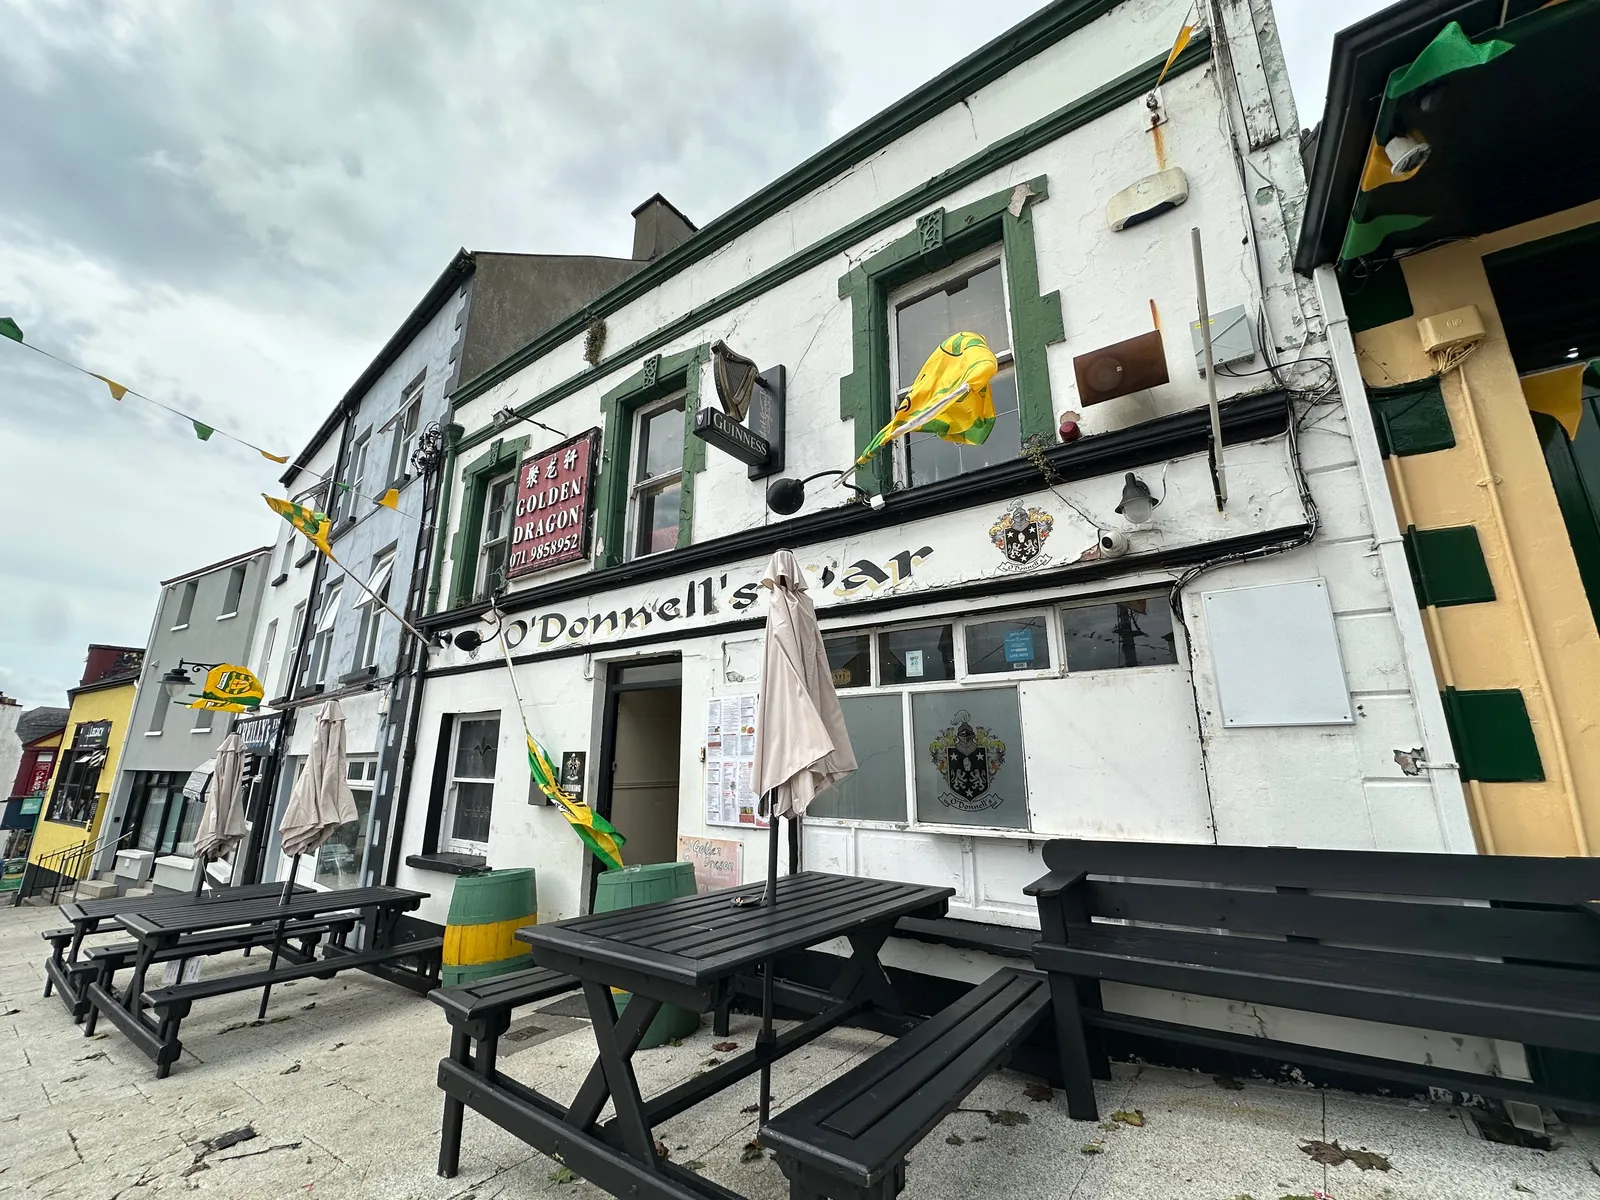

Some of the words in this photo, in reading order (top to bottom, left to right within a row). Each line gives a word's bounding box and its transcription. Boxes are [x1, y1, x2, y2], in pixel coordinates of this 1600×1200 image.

[713, 412, 767, 456] GUINNESS
[516, 476, 583, 518] GOLDEN
[512, 505, 580, 545] DRAGON
[500, 573, 759, 652] O'Donnell's
[950, 798, 993, 811] O'Donnell's
